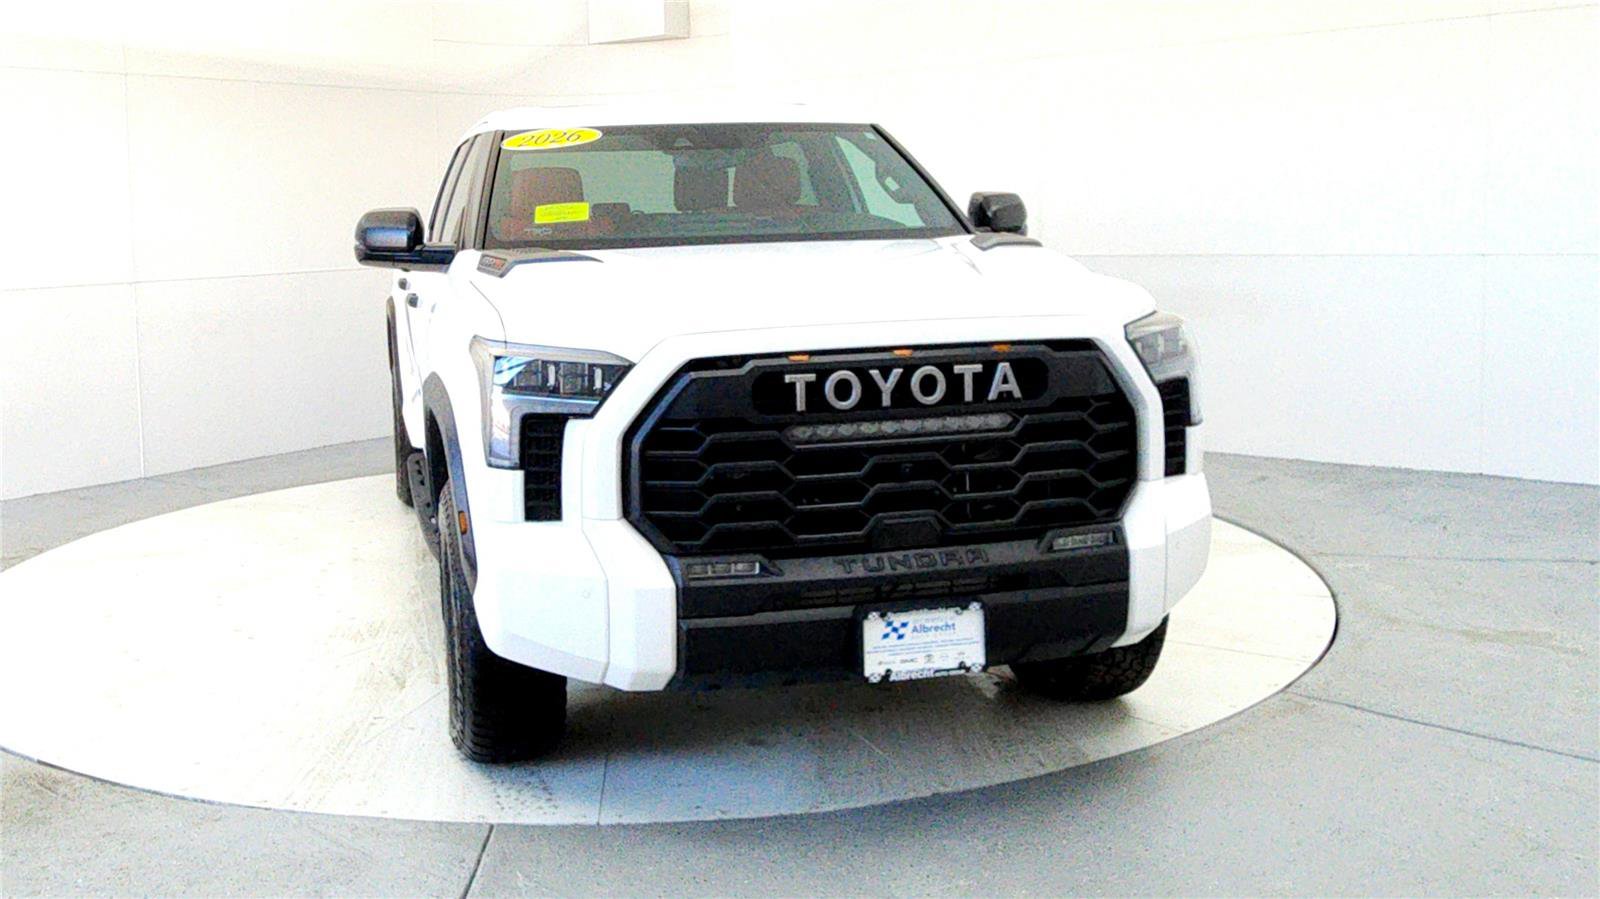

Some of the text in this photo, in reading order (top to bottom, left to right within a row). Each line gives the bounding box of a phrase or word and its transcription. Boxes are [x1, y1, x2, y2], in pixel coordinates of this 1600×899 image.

[518, 131, 584, 147] 2026
[785, 362, 1022, 411] TOYOTA
[833, 548, 989, 574] TUNDRA
[911, 622, 956, 634] Albrecht
